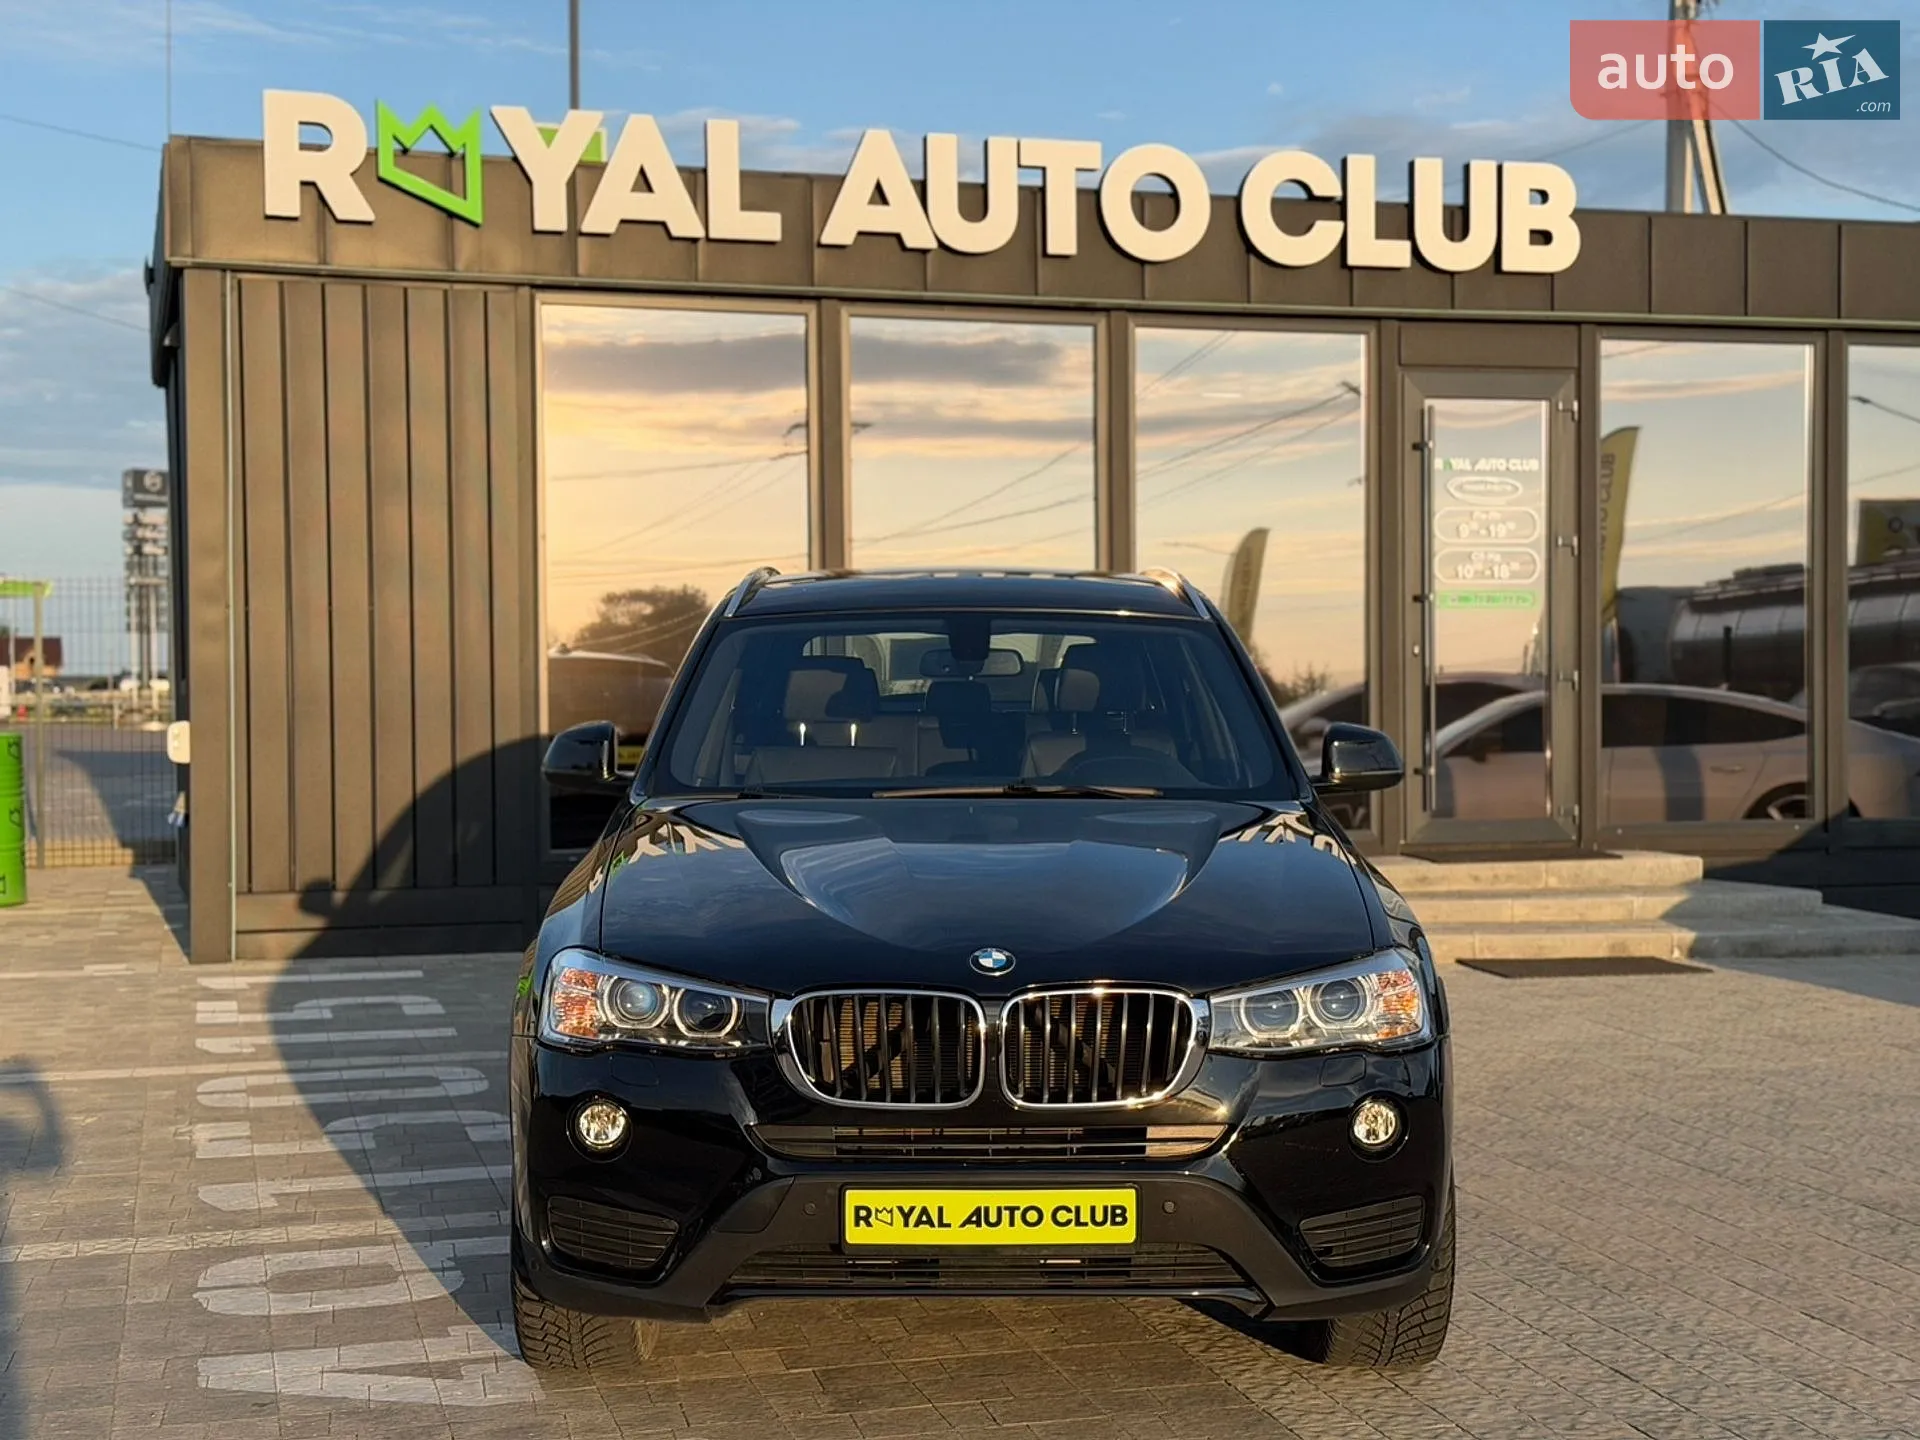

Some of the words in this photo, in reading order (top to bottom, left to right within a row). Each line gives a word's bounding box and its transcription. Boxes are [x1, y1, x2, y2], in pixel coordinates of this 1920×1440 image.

[820, 129, 1212, 265] AUTO
[1241, 150, 1582, 275] CLUB
[959, 1205, 1044, 1228] AUTO
[1051, 1205, 1128, 1228] CLUB
